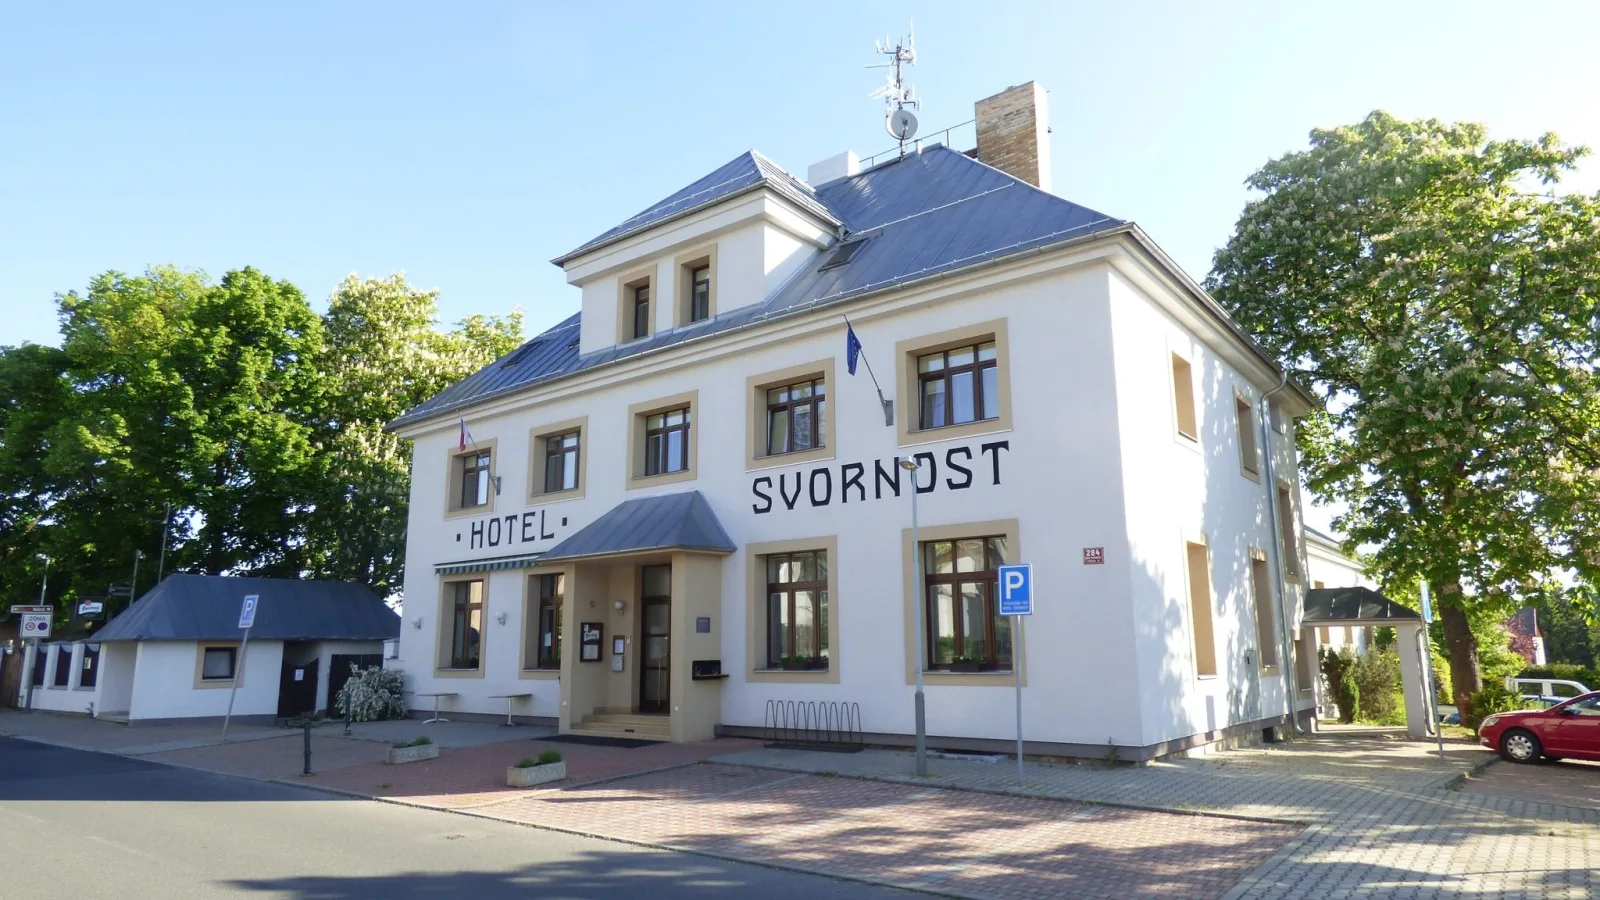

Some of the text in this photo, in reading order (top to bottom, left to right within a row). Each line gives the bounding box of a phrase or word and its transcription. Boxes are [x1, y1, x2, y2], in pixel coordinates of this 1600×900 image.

[752, 440, 1010, 515] SVORNOST
[471, 510, 554, 549] HOTEL
[1005, 571, 1024, 599] P
[243, 600, 254, 617] P
